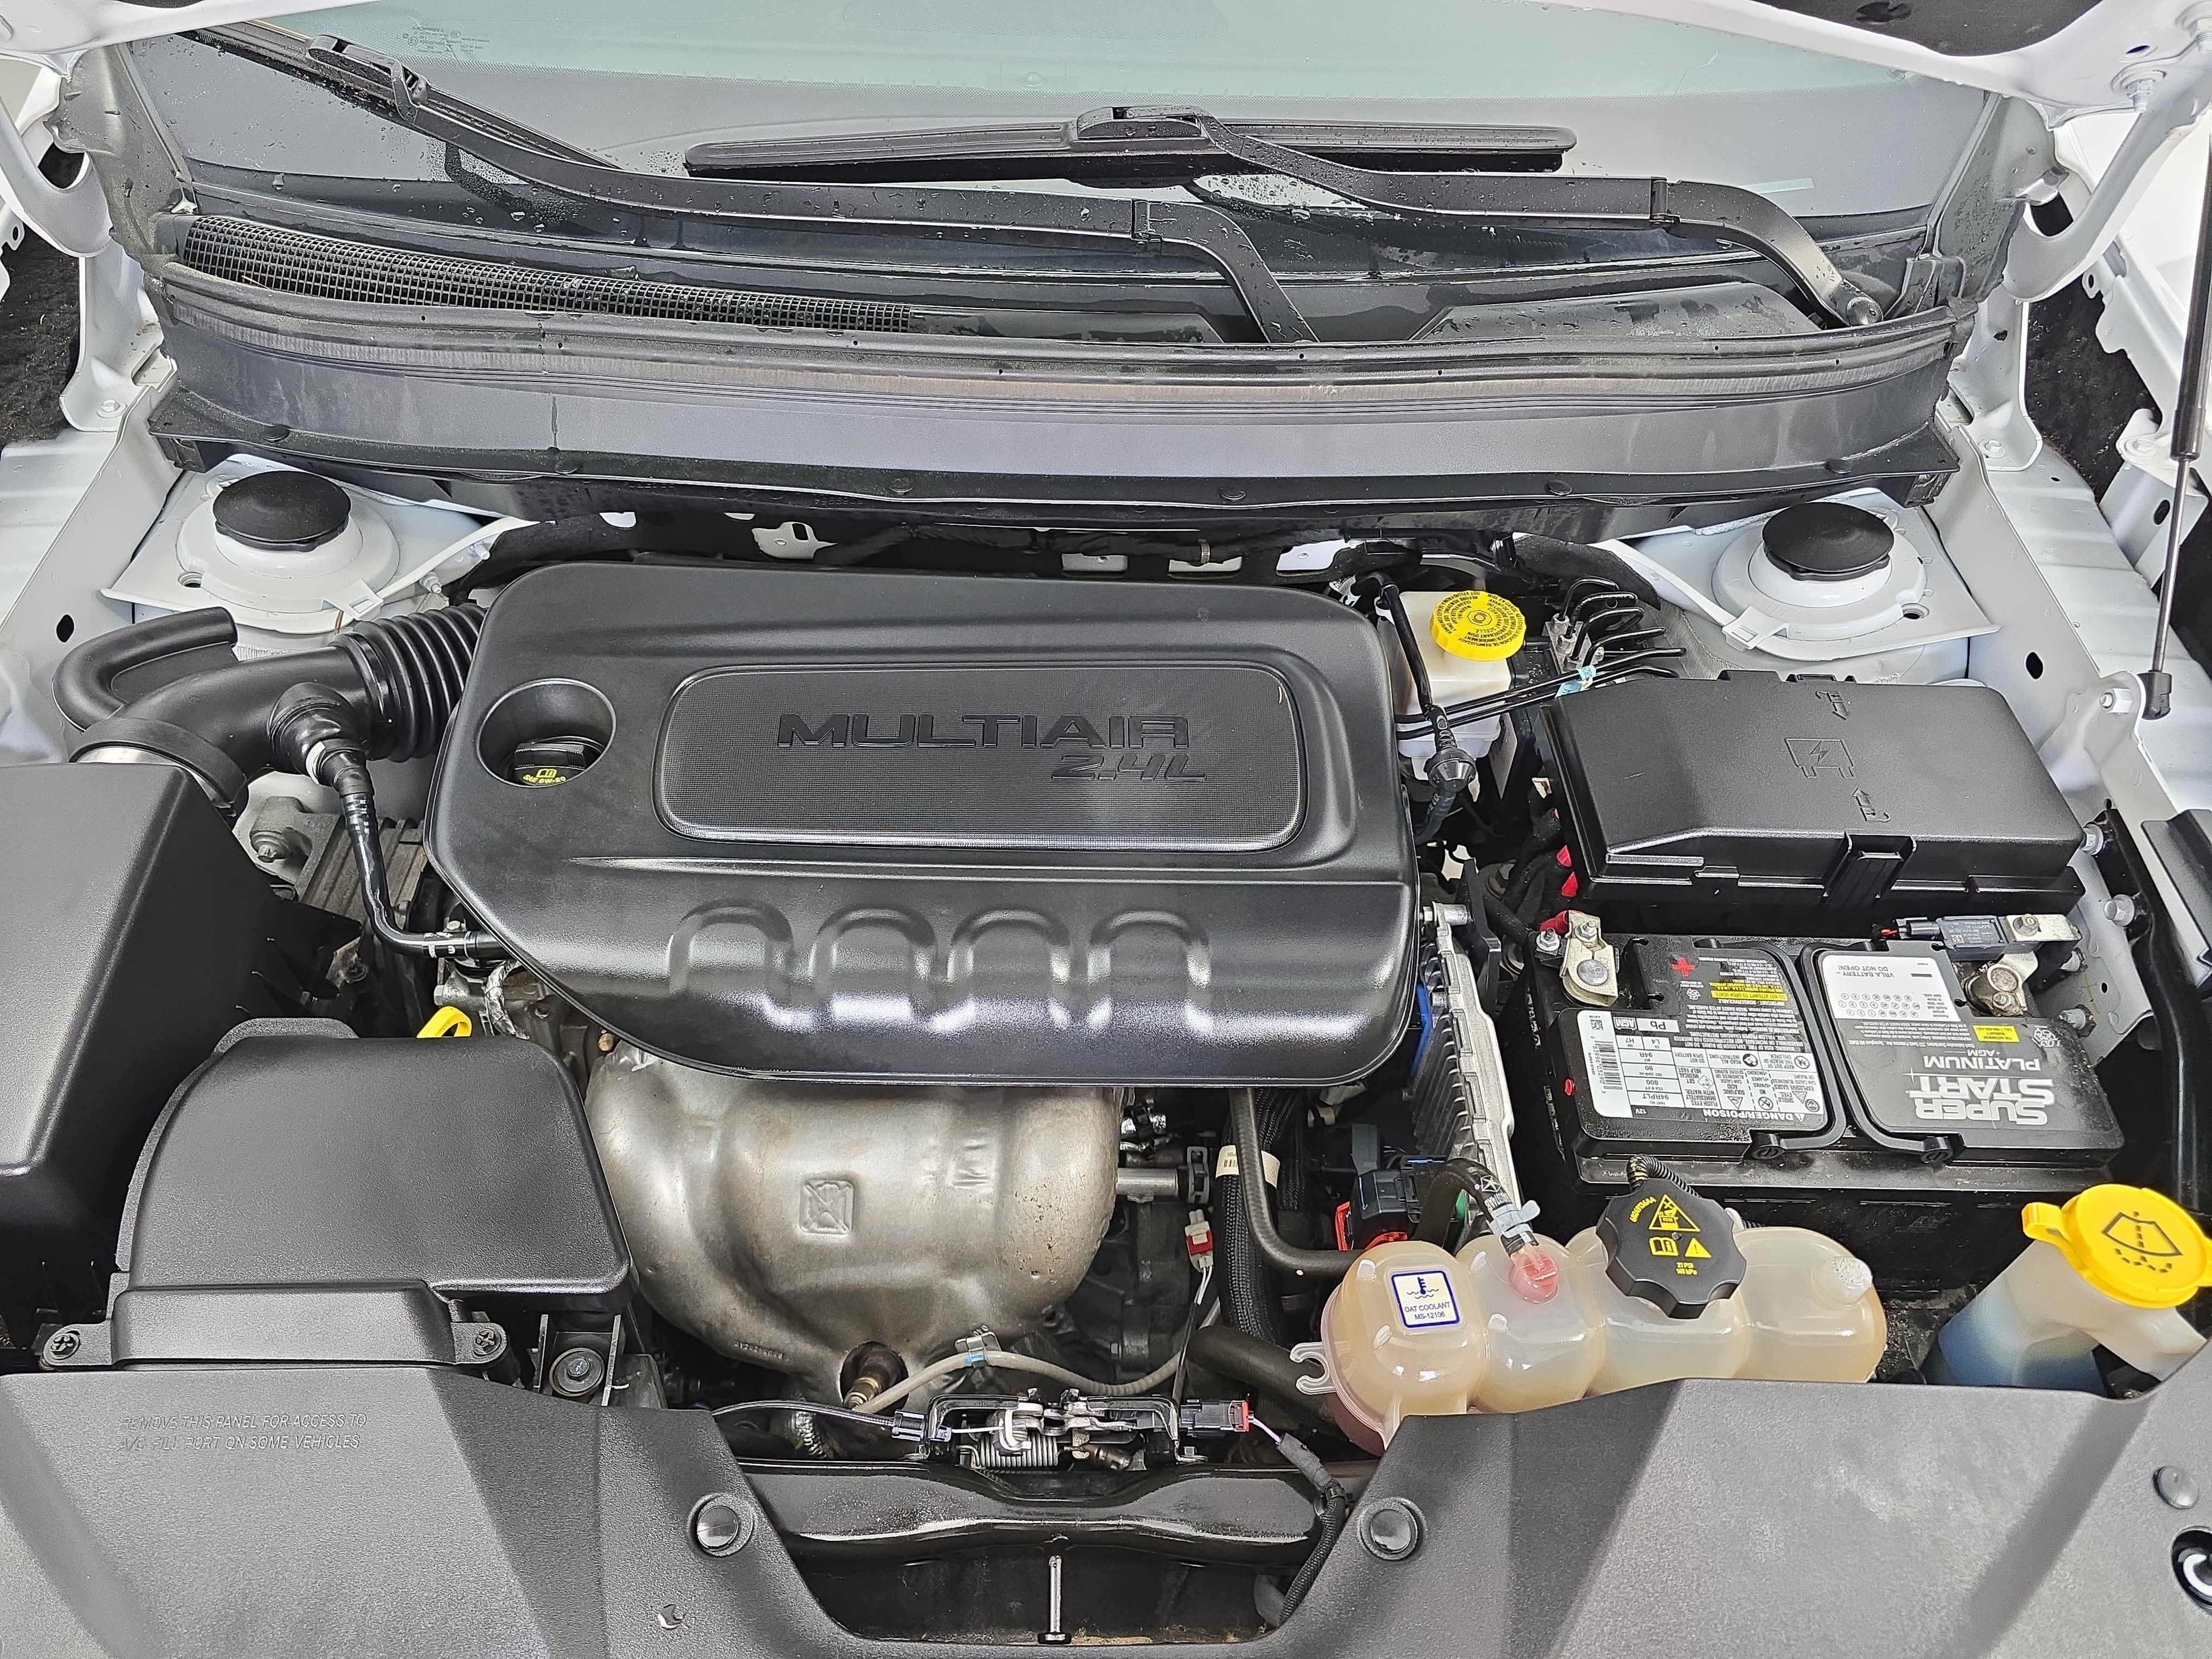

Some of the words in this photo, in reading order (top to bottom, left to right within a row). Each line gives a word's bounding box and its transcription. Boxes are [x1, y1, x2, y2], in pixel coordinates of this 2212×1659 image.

[777, 713, 1188, 749] MULTIAIR
[1052, 755, 1207, 781] 2.4L
[523, 774, 539, 783] SAE
[1615, 1018, 1634, 1028] AGM
[1650, 1020, 1666, 1030] Pb
[1923, 1056, 2041, 1071] PLATINUM
[1908, 1076, 2055, 1105] START
[1703, 1109, 1793, 1120] DANGER/POISON
[1914, 1098, 2047, 1125] SUPER
[1418, 1301, 1450, 1311] COOLANT
[1414, 1311, 1445, 1320] MS-12106
[123, 1416, 179, 1430] REMOVE
[182, 1416, 213, 1429] THIS
[217, 1415, 258, 1429] PANEL
[262, 1414, 290, 1428] FOR
[293, 1413, 346, 1427] ACCESS
[350, 1413, 367, 1427] TO
[186, 1436, 221, 1450] PORT
[225, 1436, 245, 1450] ON
[249, 1436, 290, 1449] SOME
[295, 1435, 360, 1449] VEHICLES
